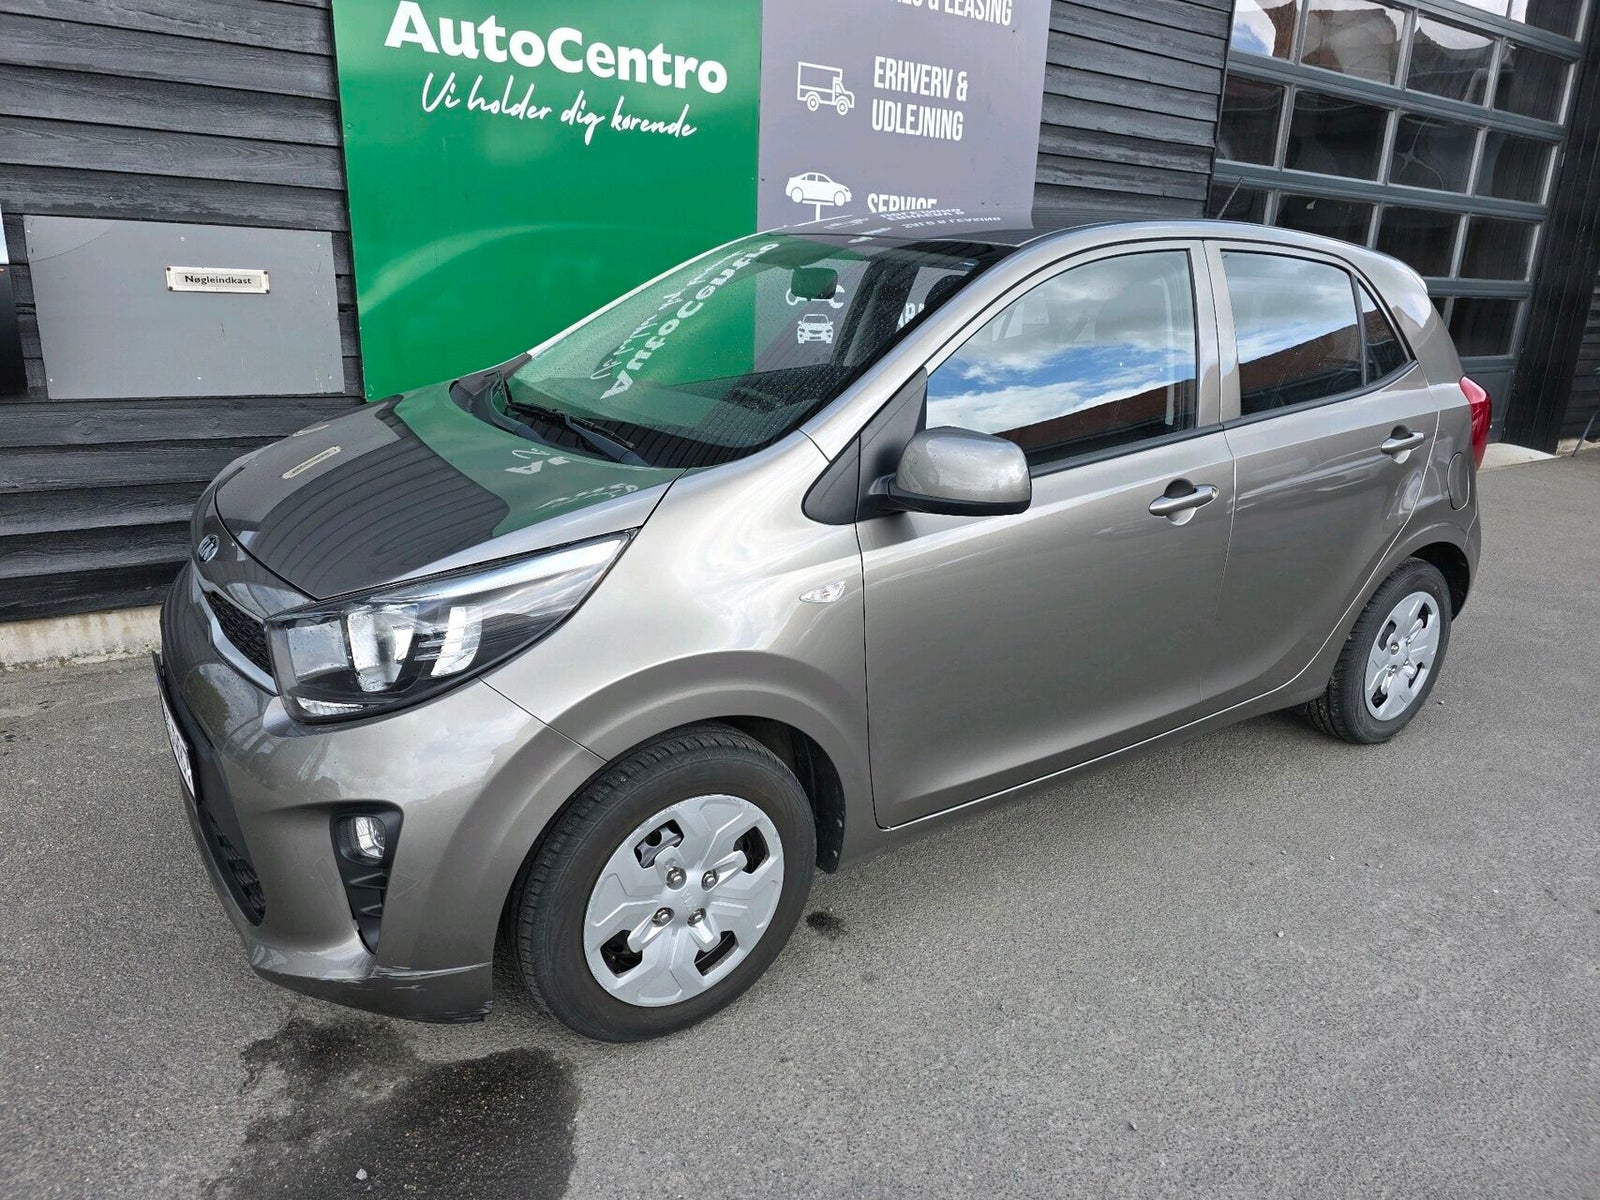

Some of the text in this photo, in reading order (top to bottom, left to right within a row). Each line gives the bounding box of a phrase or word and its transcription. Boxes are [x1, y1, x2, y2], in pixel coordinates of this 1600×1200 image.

[384, 1, 728, 94] AutoCentro
[874, 56, 968, 101] ERHVERV &
[421, 72, 698, 145] Vi holder dig kørende
[872, 98, 964, 141] UDLEJNING
[184, 275, 252, 285] Nøgleindkast
